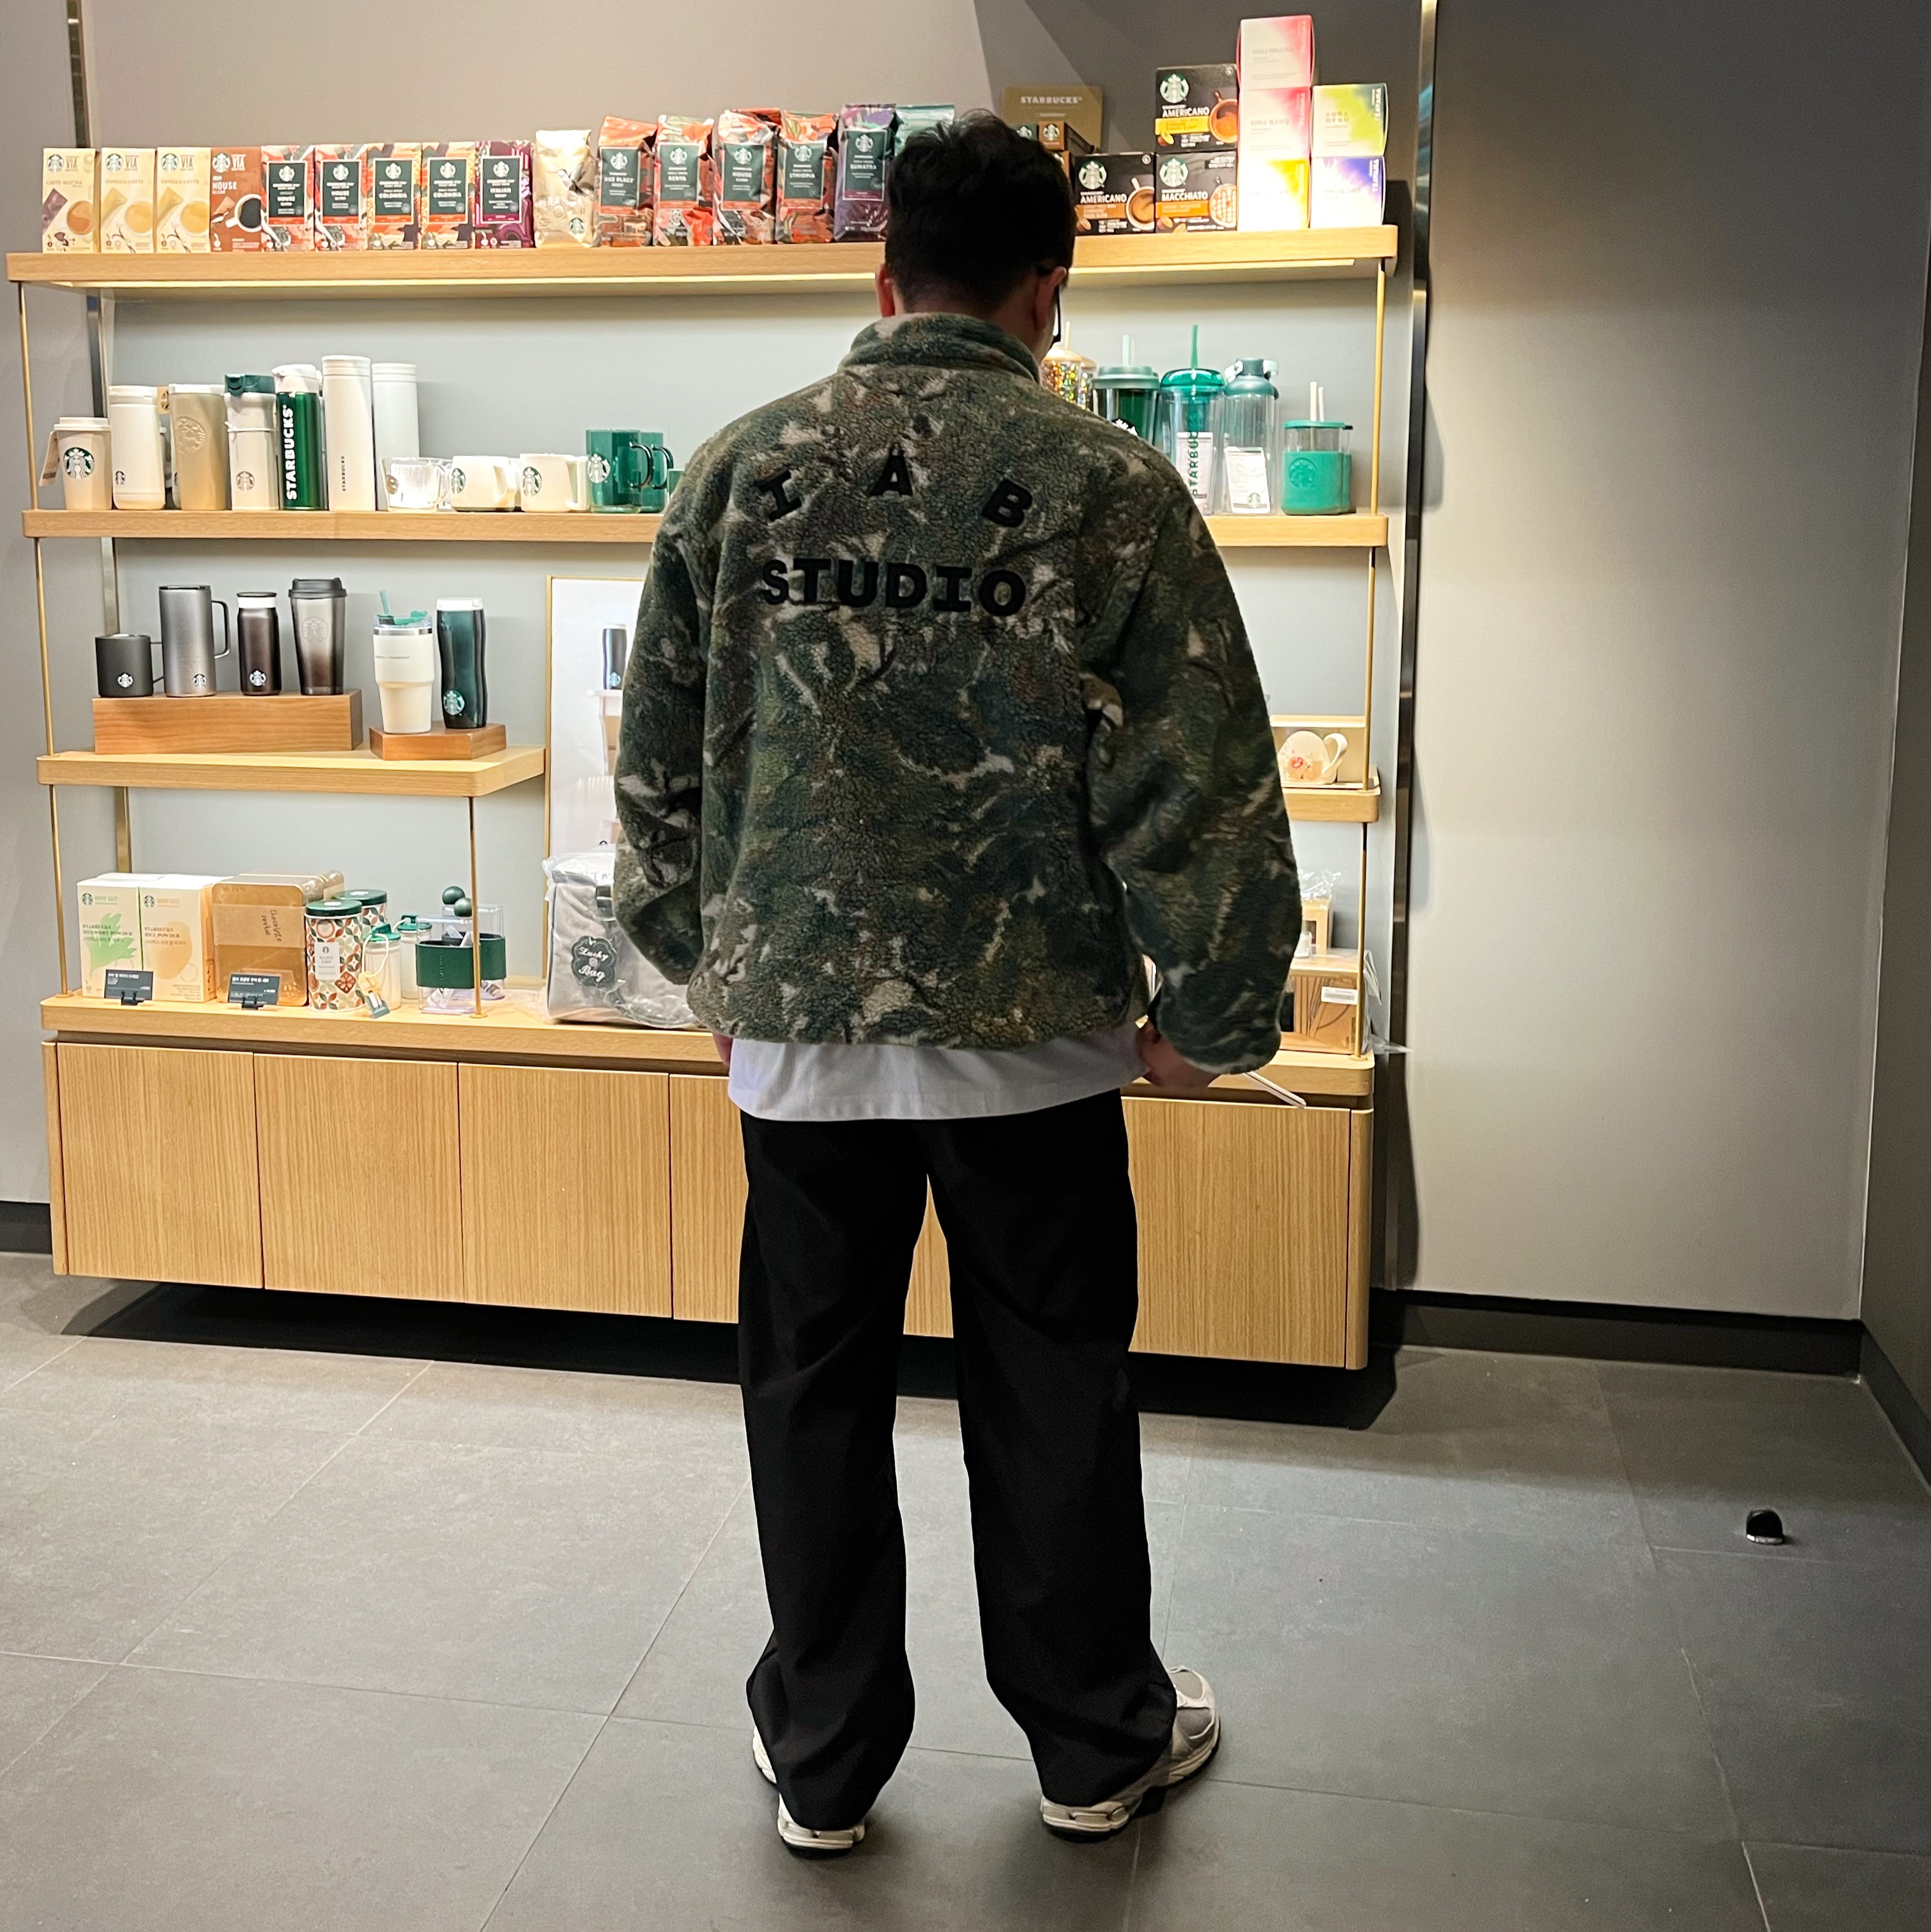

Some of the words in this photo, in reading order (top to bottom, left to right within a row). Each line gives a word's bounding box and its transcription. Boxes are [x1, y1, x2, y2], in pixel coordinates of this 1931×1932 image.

[1021, 96, 1078, 104] STARBUCKS
[1162, 107, 1210, 118] AMERICANO
[65, 156, 79, 172] VIA
[124, 155, 139, 172] VIA
[180, 155, 195, 171] VIA
[231, 154, 246, 171] VIA
[212, 181, 238, 190] HOUSE
[1080, 193, 1127, 204] AMERICANO
[1161, 191, 1209, 202] MACCHIATO
[282, 406, 297, 500] STARBUCKS
[763, 557, 1026, 617] STUDIO
[579, 947, 609, 961] Lucky
[578, 965, 606, 982] Bag
